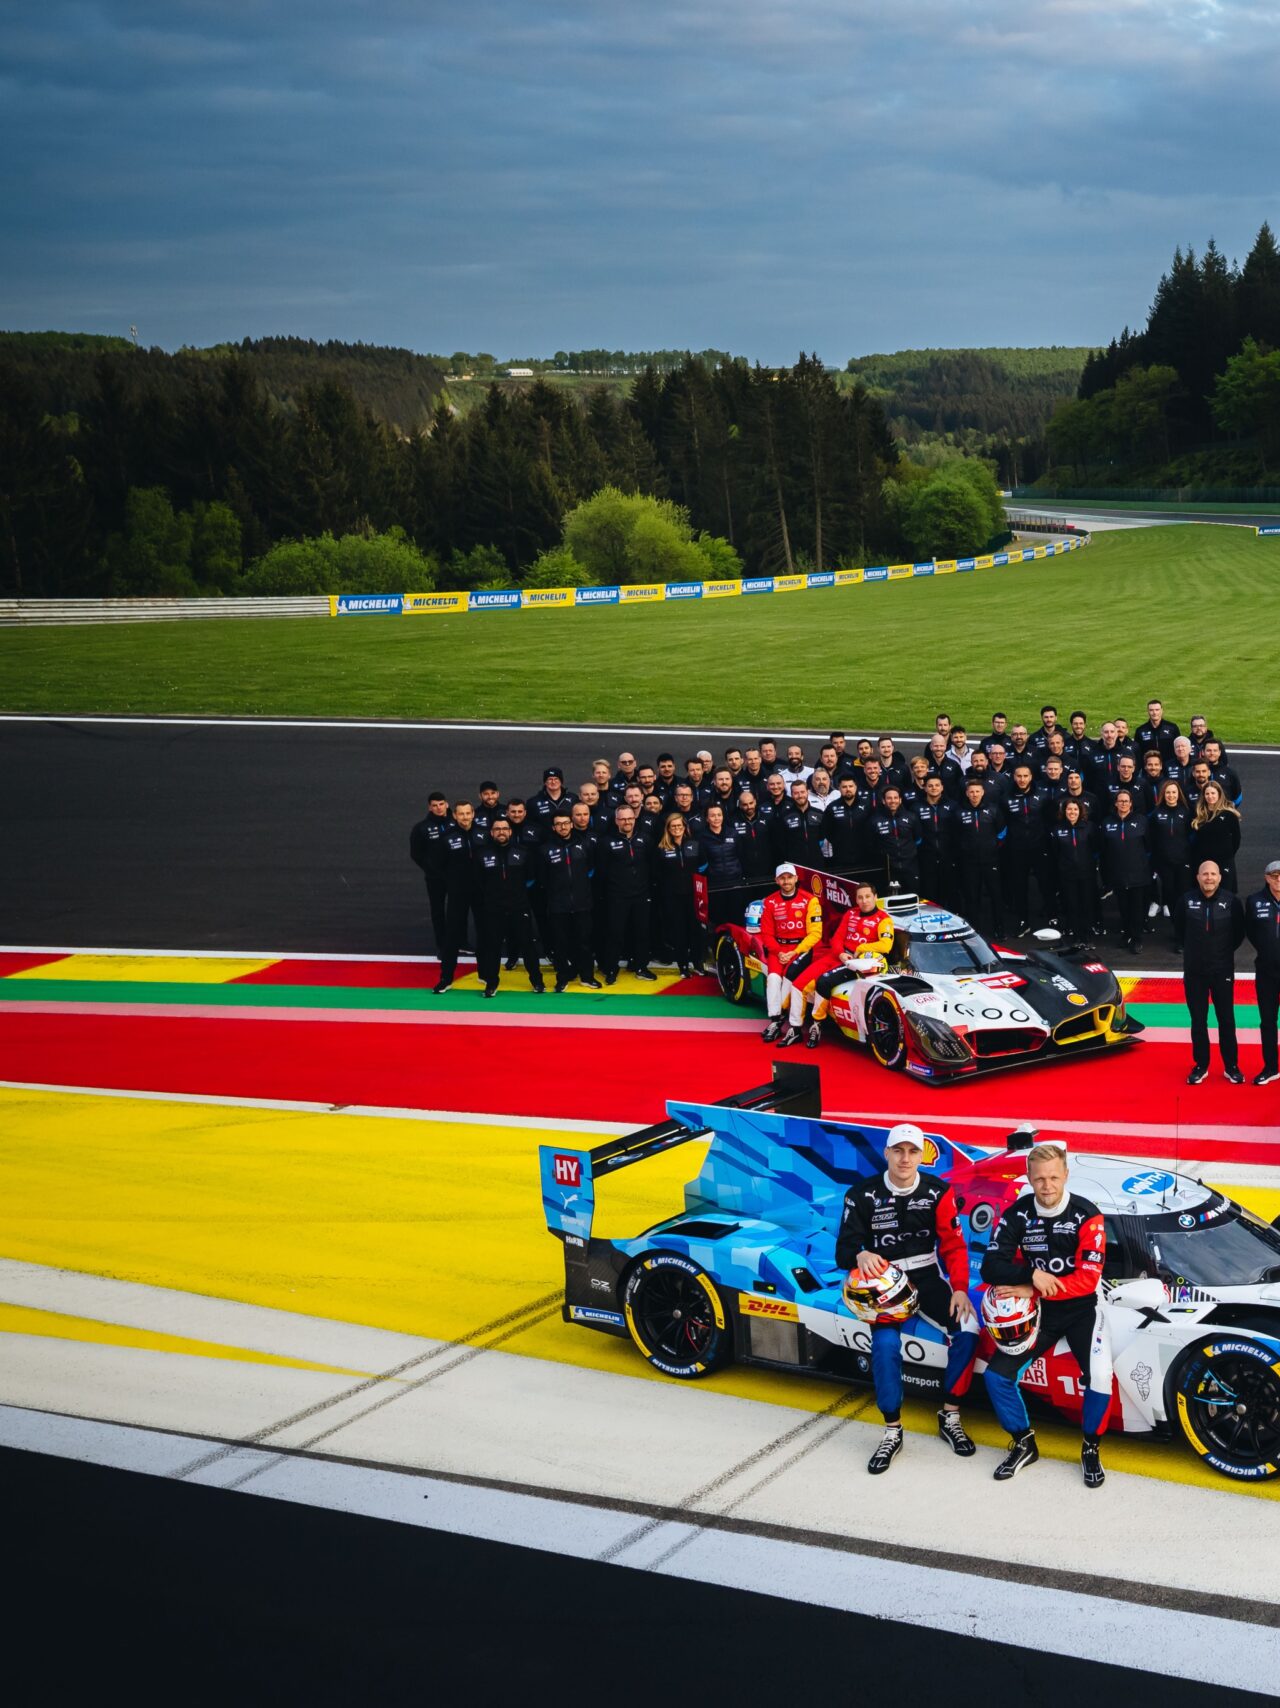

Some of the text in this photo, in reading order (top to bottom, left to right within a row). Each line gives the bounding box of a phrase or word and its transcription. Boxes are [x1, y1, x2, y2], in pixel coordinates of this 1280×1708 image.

[627, 588, 658, 596] MICHELIN
[672, 585, 700, 594] MICHELIN
[708, 583, 736, 592] MICHELIN
[478, 594, 518, 604] MICHELIN
[530, 592, 567, 601] MICHELIN
[583, 590, 616, 600] MICHELIN
[349, 598, 399, 610] MICHELIN
[413, 598, 458, 607] MICHELIN
[826, 879, 837, 889] Shell
[826, 887, 852, 907] HELIX
[1086, 963, 1104, 973] HY
[832, 1004, 854, 1022] 20
[944, 1000, 1030, 1022] iQOO
[556, 1159, 578, 1182] HY
[873, 1230, 931, 1248] iQOO
[658, 1257, 697, 1274] MICHELIN
[590, 1278, 610, 1289] OZ
[747, 1300, 791, 1316] DHL
[585, 1310, 620, 1322] MICHELIN
[841, 1328, 926, 1362] iQO
[1222, 1343, 1272, 1362] MICHELIN
[652, 1358, 691, 1374] MICHELIN
[901, 1373, 940, 1388] torsport
[1024, 1370, 1045, 1384] AR
[1208, 1456, 1257, 1476] MICHELIN
